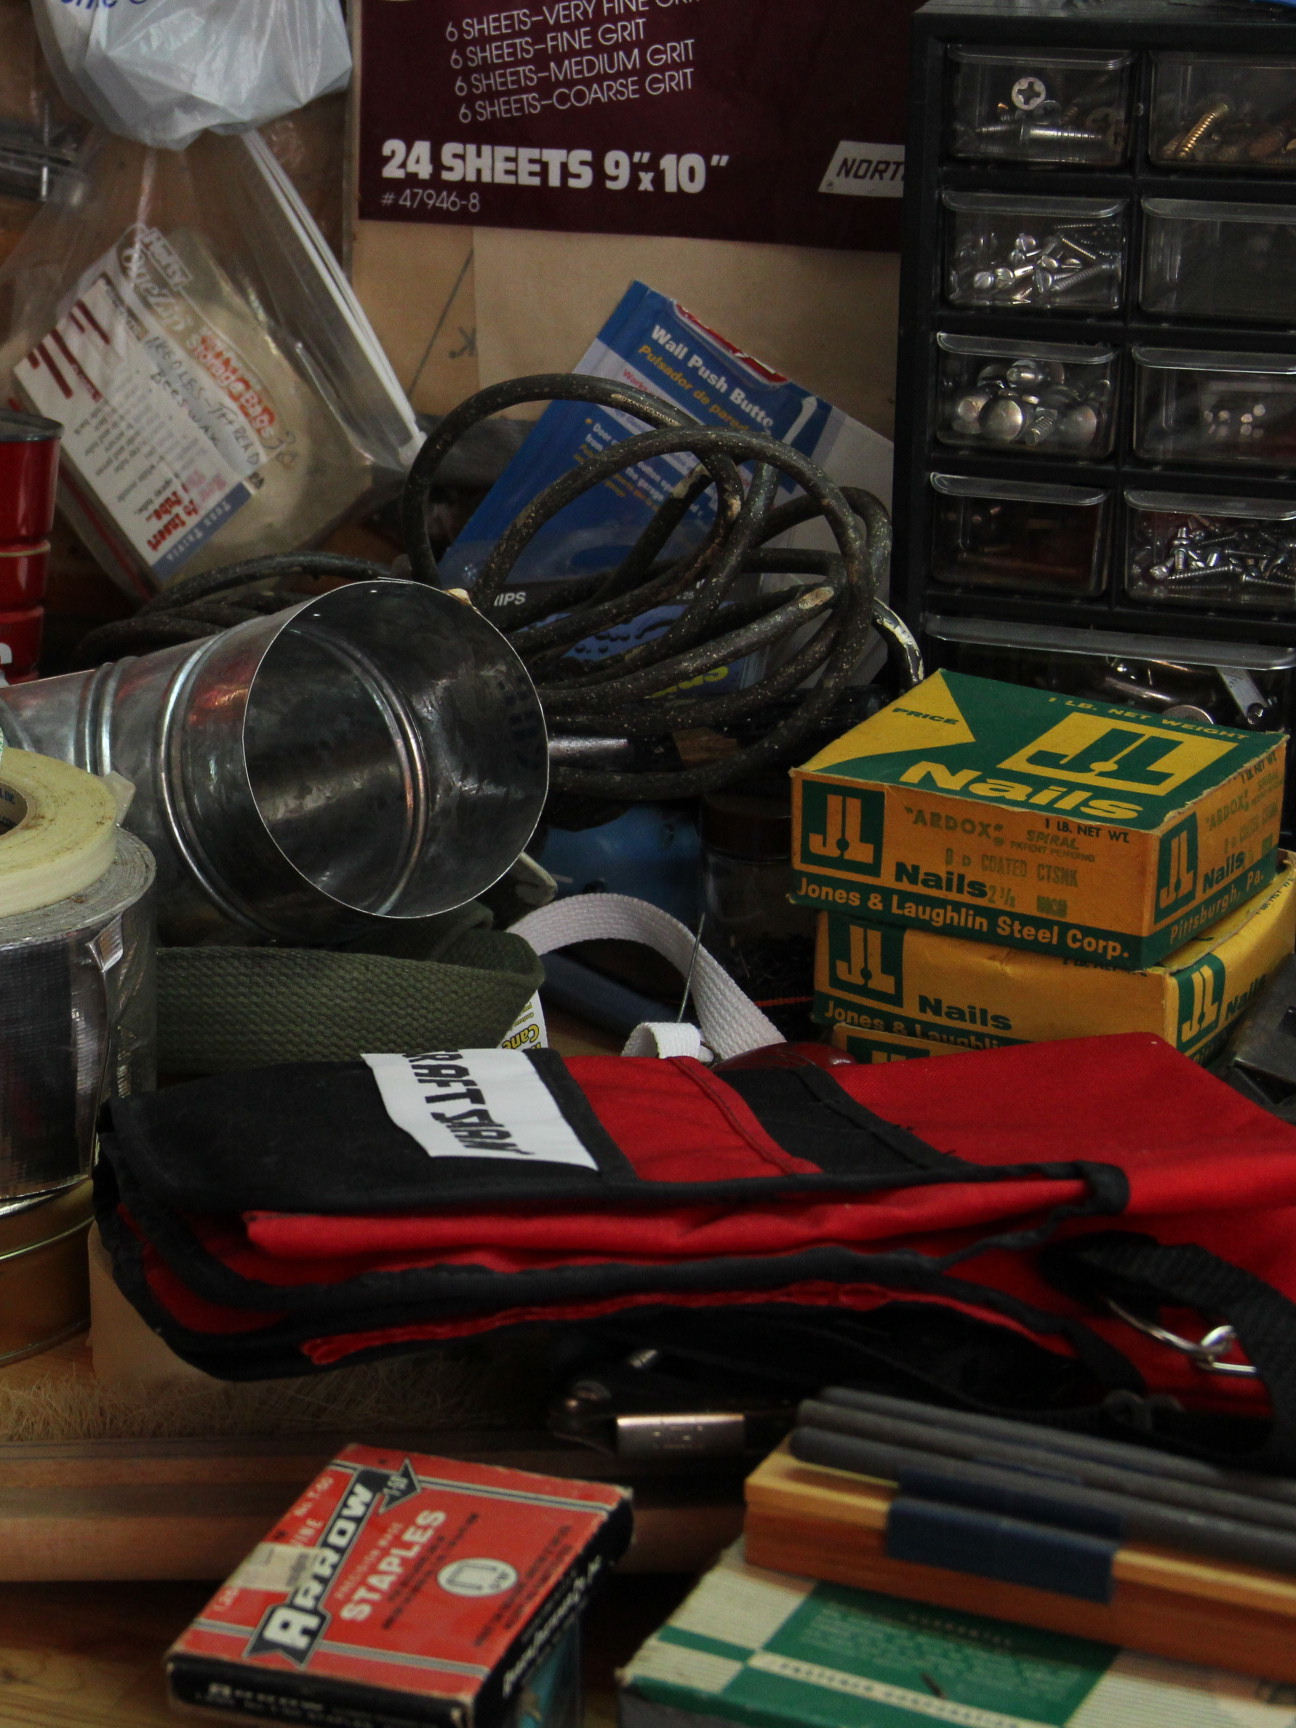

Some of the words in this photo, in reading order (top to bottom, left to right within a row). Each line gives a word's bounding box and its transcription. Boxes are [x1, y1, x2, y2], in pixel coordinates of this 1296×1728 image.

[446, 21, 458, 42] 6
[450, 49, 463, 69] 6
[598, 18, 647, 45] GRIT
[454, 76, 468, 97] 6
[646, 39, 695, 66] GRIT
[458, 103, 472, 124] 6
[645, 68, 695, 95] GRIT
[381, 138, 434, 180] 24
[440, 142, 594, 189] SHEETS
[836, 157, 905, 182] NORT
[380, 188, 481, 213] #47946-8
[638, 344, 694, 391] Pulsador
[693, 387, 710, 405] de
[650, 324, 689, 360] Wall
[686, 353, 728, 394] Push
[892, 707, 960, 726] PRICE
[1064, 700, 1097, 711] LB.
[1107, 708, 1153, 721] NET
[1162, 718, 1250, 740] WEIGHT
[898, 760, 1144, 820] Nails
[1026, 829, 1079, 850] SPIRAL
[1044, 818, 1050, 829] 1
[1056, 820, 1072, 834] LB.
[1077, 824, 1101, 838] NET
[894, 861, 988, 899] Nails
[981, 853, 1027, 878] COATED
[1203, 851, 1245, 895] Nails
[1246, 869, 1264, 892] Pa.
[797, 877, 861, 906] Jones
[869, 891, 884, 911] &
[891, 894, 989, 933] Laughlin
[996, 916, 1059, 945] Steel
[1066, 928, 1130, 960] Corp.
[824, 1000, 885, 1031] Jones
[891, 1017, 908, 1036] &
[917, 995, 1013, 1031] Nails
[339, 1508, 449, 1623] STAPLES
